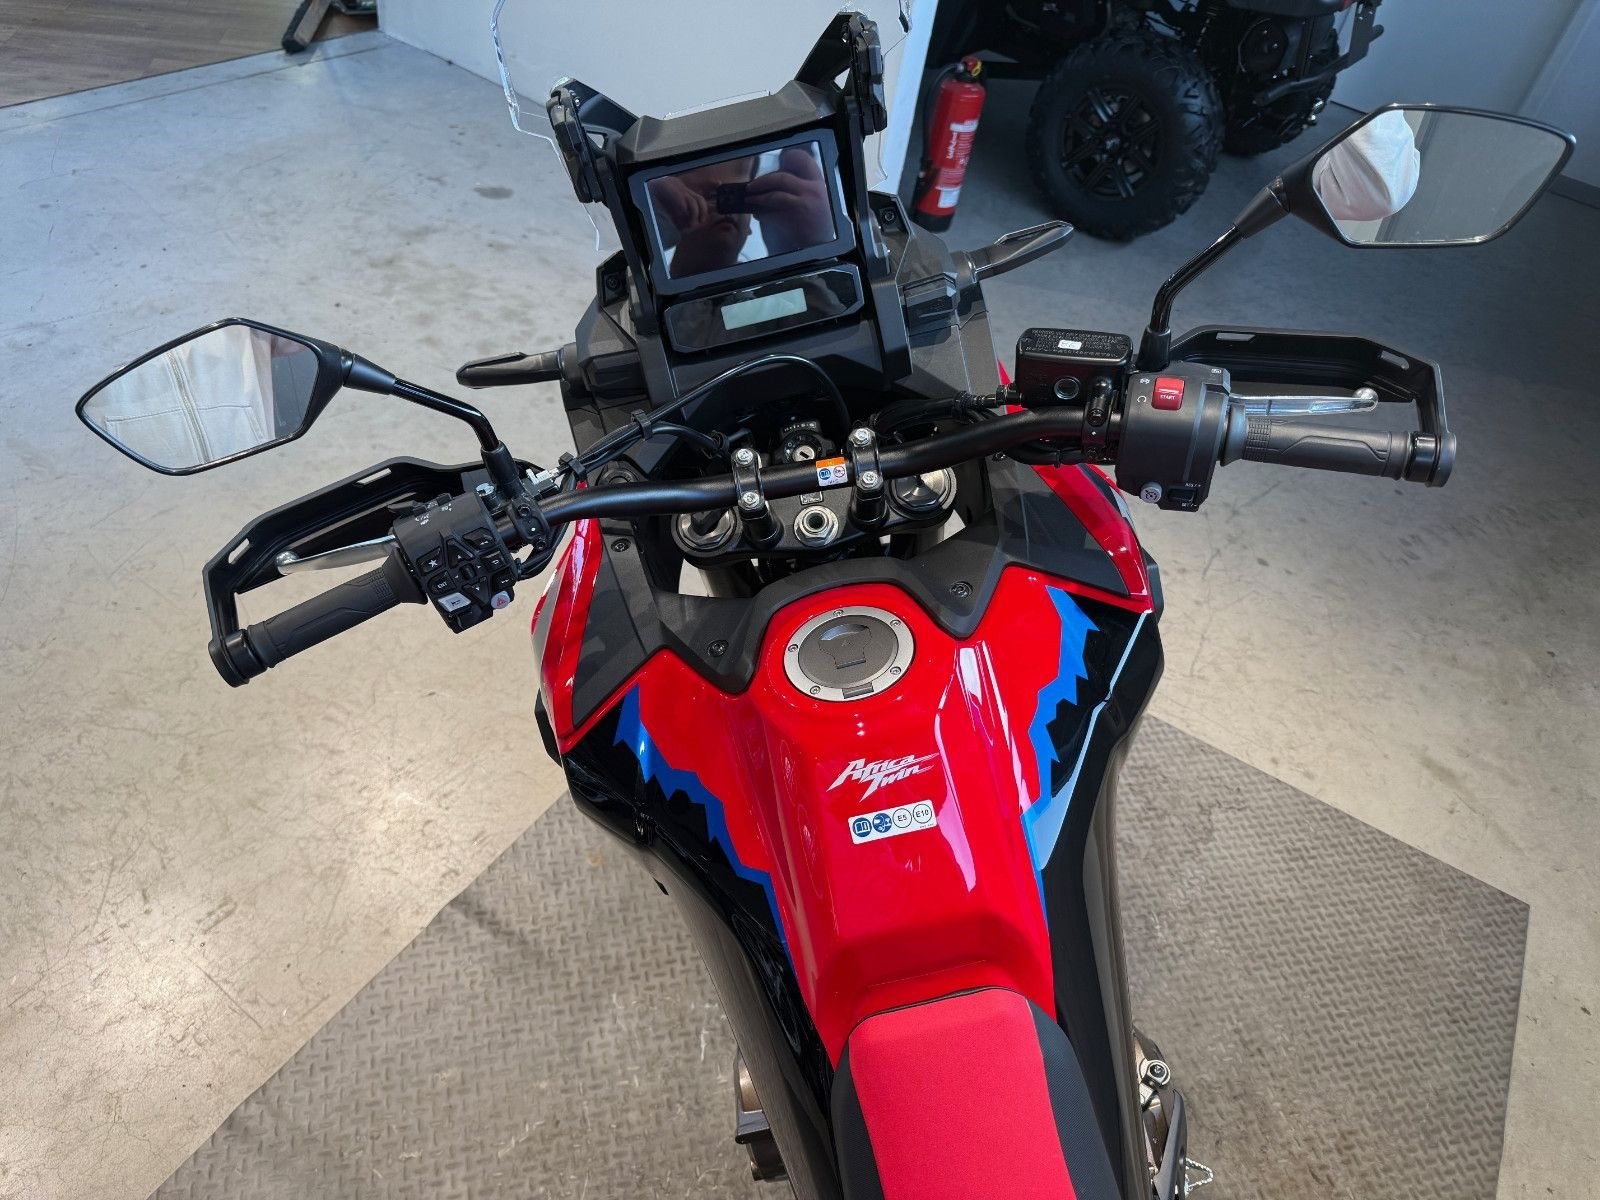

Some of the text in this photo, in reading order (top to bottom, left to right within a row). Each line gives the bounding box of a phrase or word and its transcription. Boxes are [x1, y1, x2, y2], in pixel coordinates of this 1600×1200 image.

[826, 753, 939, 792] Africa
[859, 765, 934, 802] Twin
[897, 809, 929, 822] E5 E10
